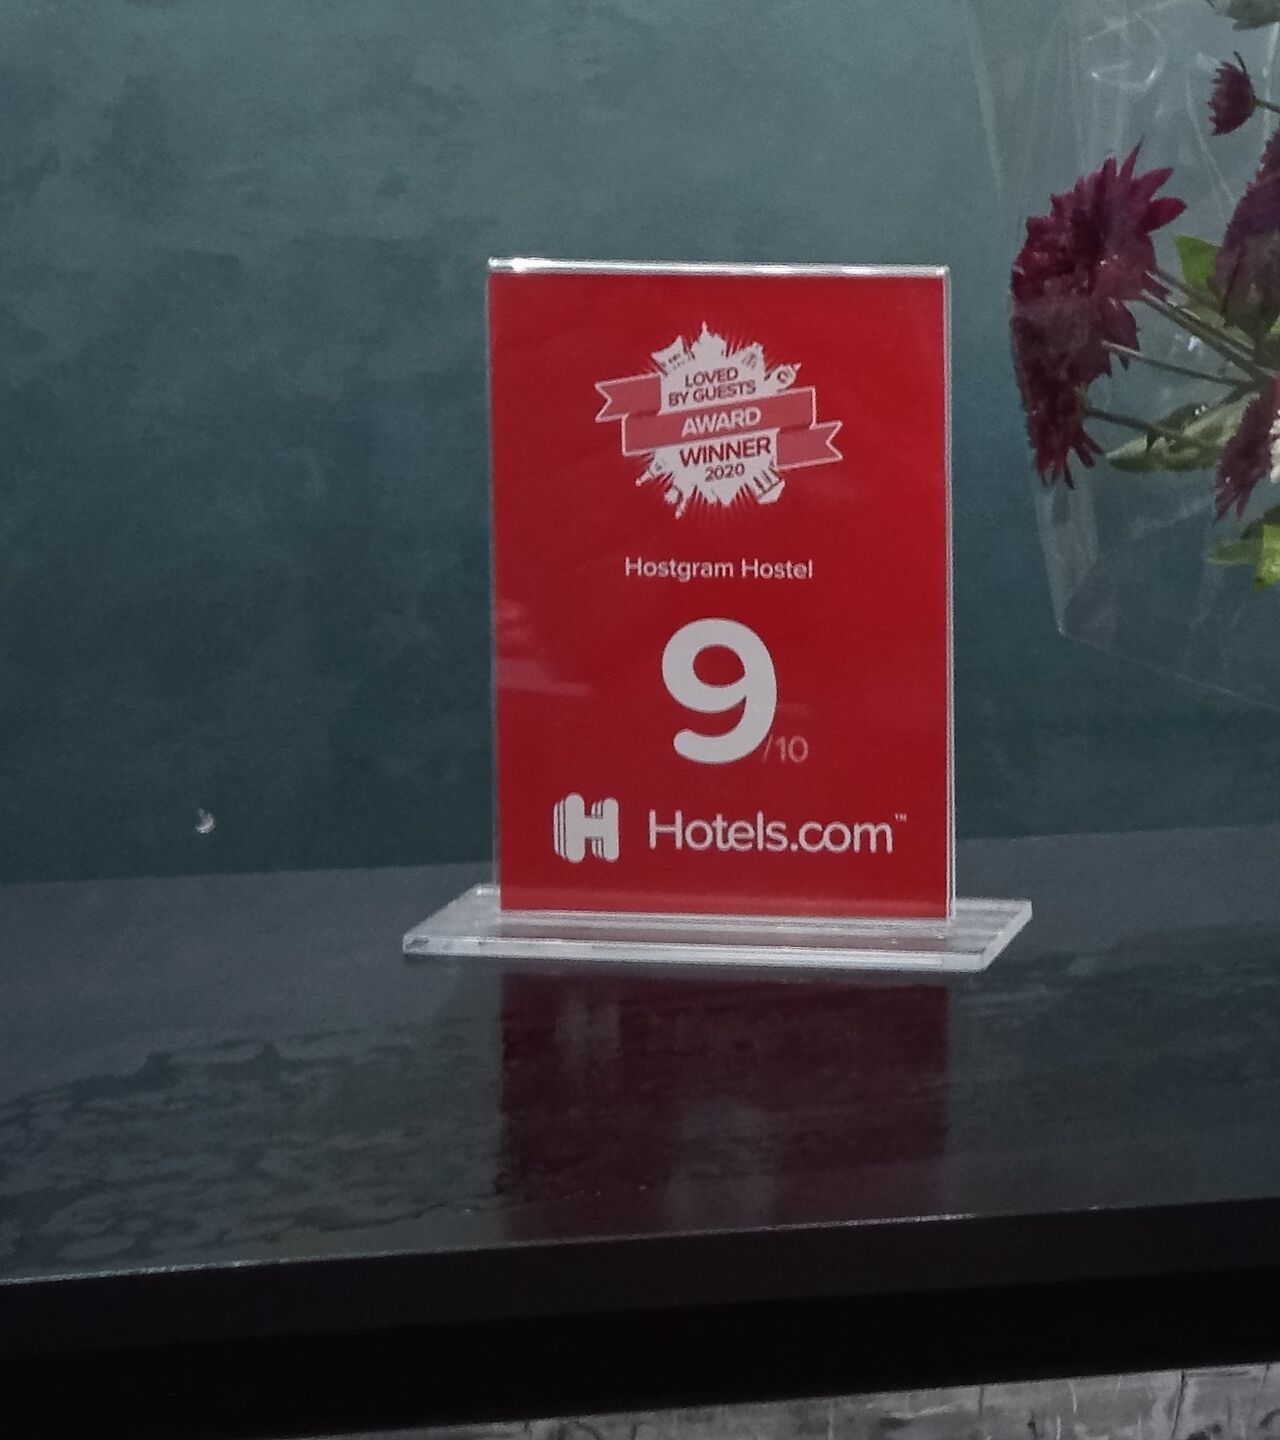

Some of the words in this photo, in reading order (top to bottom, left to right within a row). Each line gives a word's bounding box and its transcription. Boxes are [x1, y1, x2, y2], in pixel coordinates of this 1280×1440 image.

[685, 367, 739, 388] LOVED
[668, 391, 690, 407] BY
[693, 380, 756, 403] GUESTS
[681, 407, 762, 437] AWARD
[679, 437, 771, 467] WINNER
[705, 463, 745, 482] 2020
[624, 557, 734, 583] Hostgram
[741, 558, 814, 580] Hostel
[661, 617, 778, 765] 9
[649, 809, 894, 854] Hotels.com
